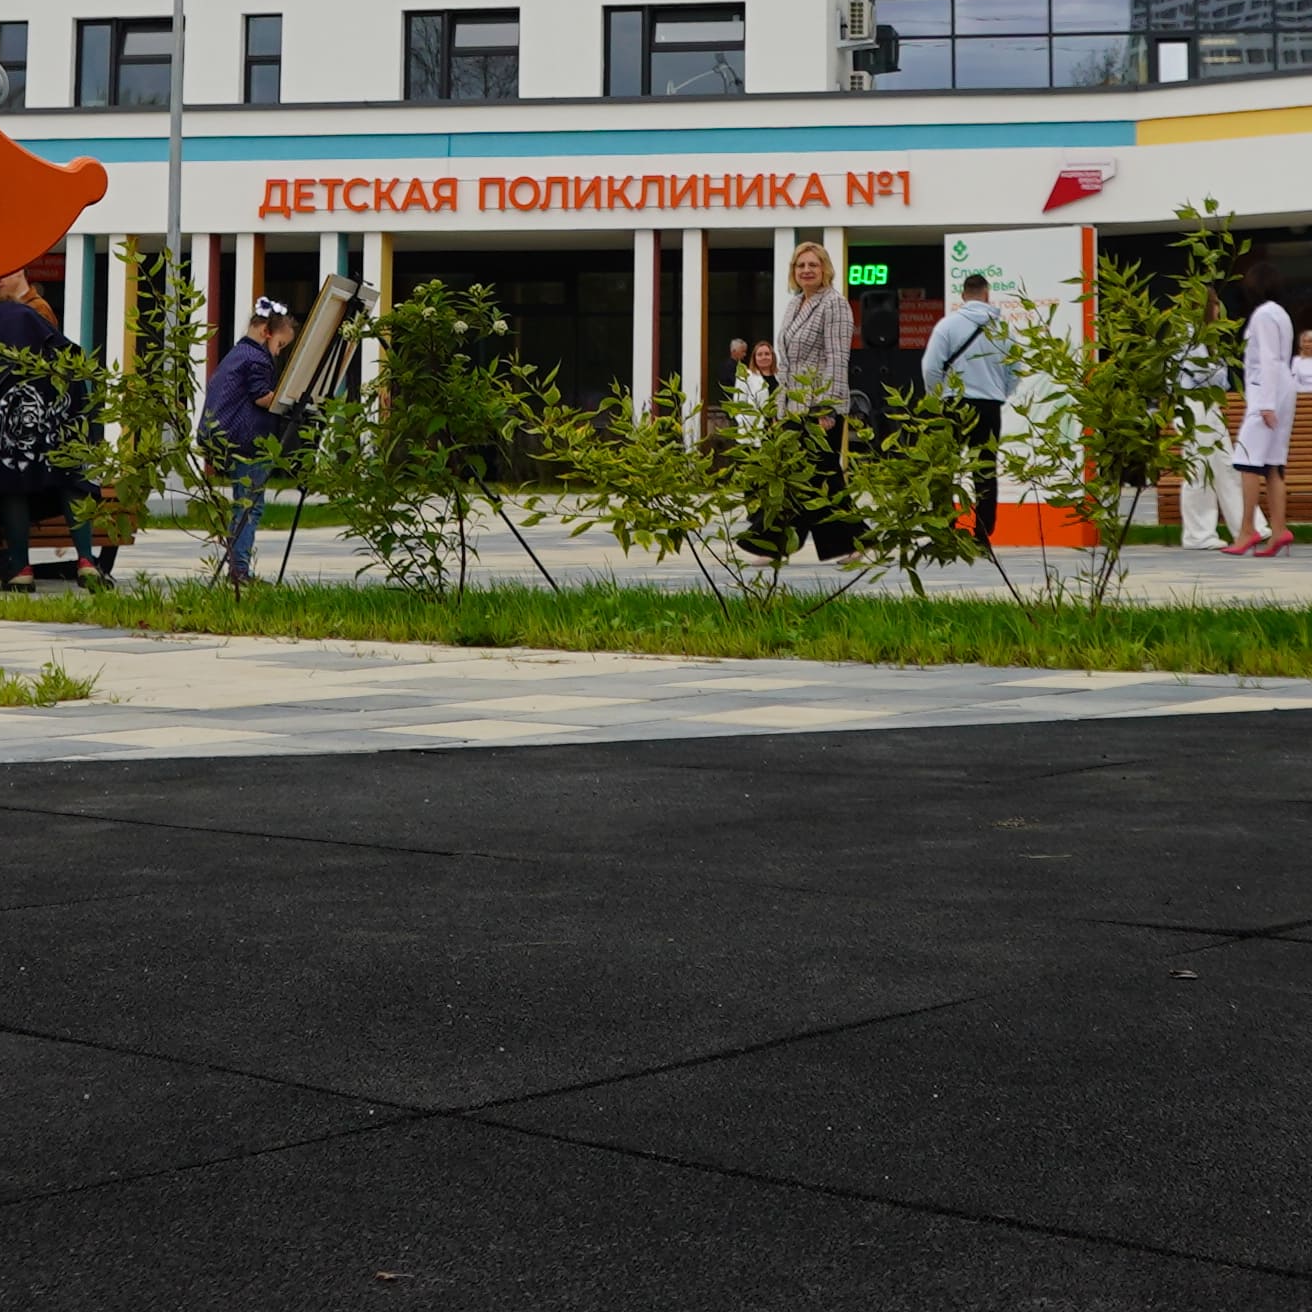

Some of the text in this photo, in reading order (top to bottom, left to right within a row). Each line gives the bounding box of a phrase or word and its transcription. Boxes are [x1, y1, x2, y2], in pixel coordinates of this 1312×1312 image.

[258, 171, 911, 220] ДЕТСКАЯ ПОЛИКЛИНИКА №1
